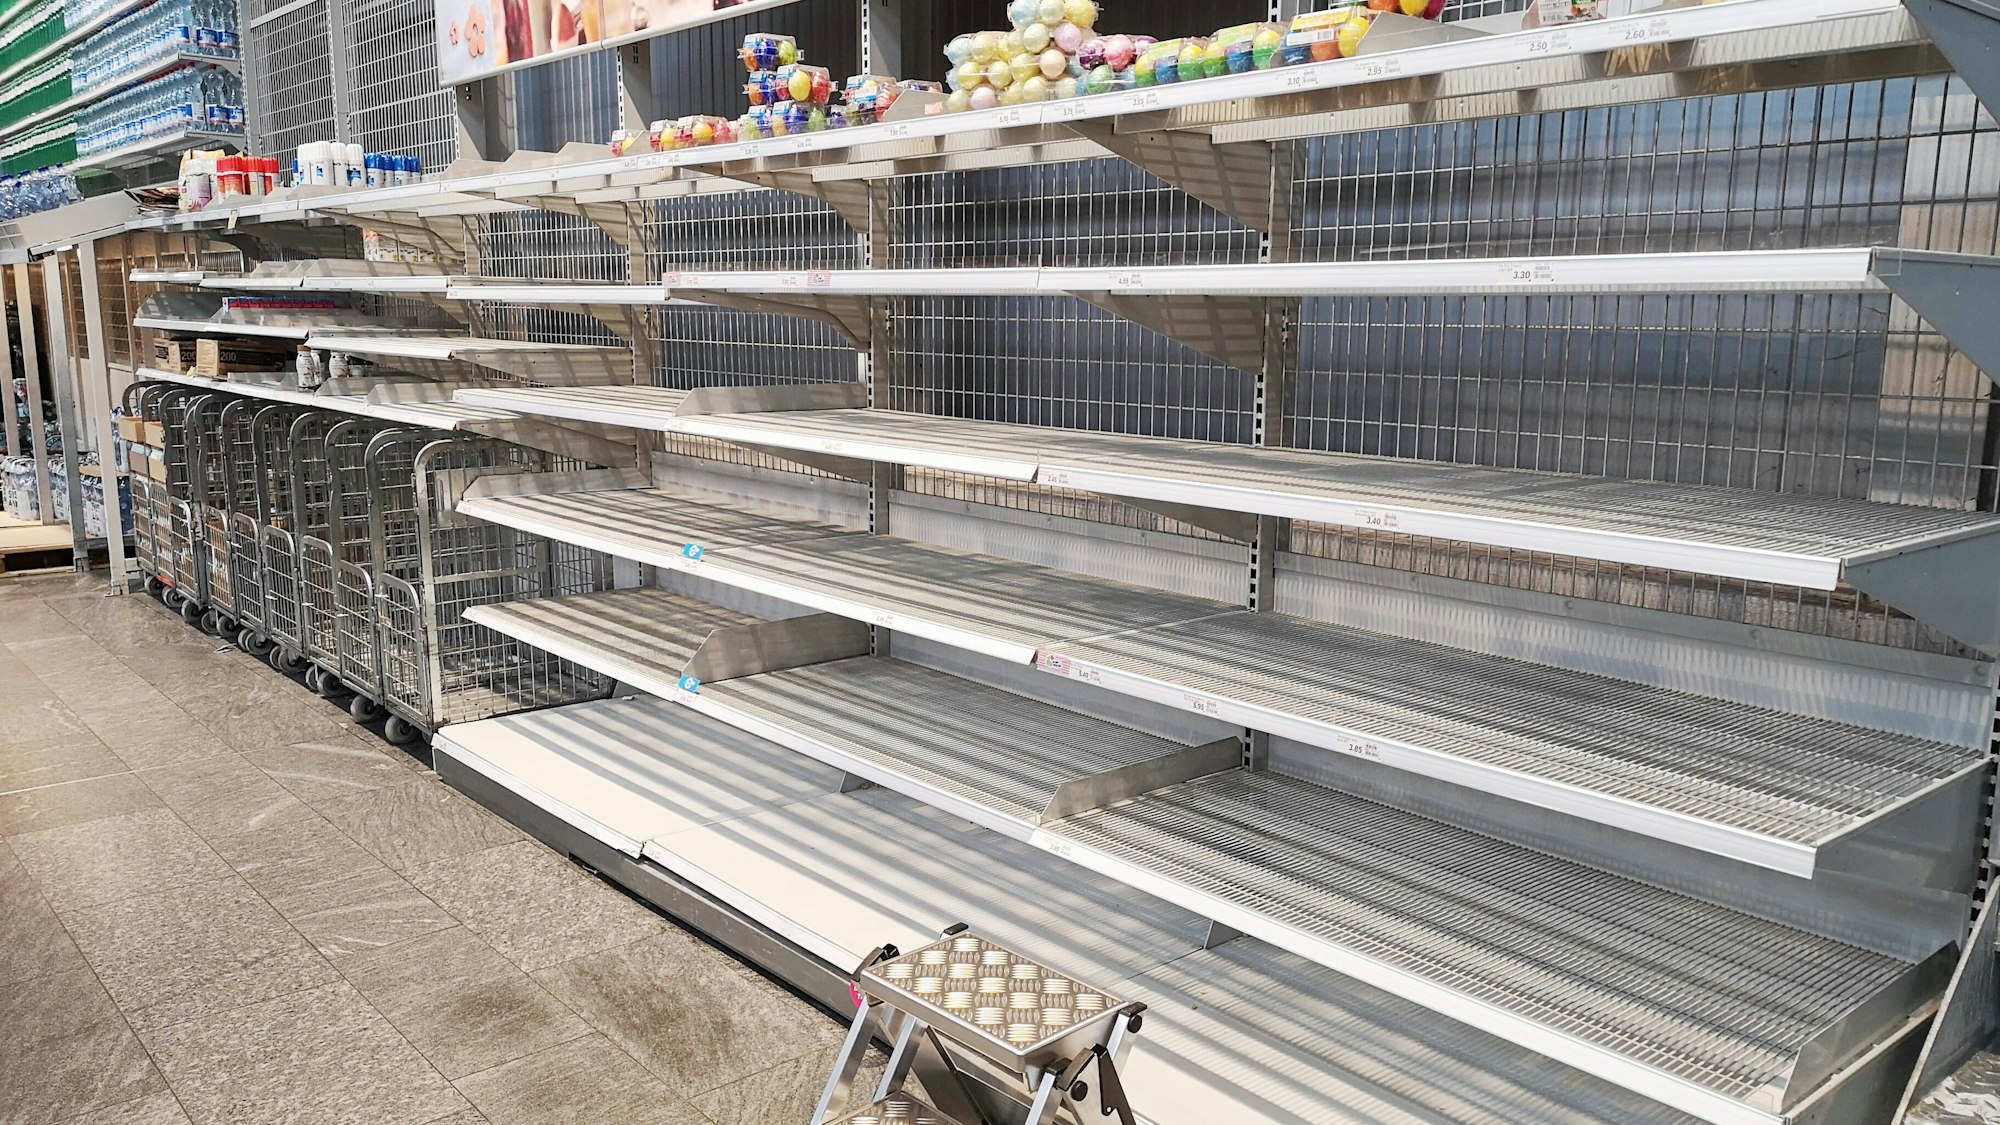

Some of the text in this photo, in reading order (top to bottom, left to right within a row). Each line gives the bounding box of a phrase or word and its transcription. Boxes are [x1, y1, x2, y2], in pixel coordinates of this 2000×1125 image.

[1625, 29, 1645, 40] 2.60
[1529, 41, 1548, 52] 2.50
[1367, 66, 1383, 77] 2.95
[1287, 76, 1301, 86] 3.10
[1513, 271, 1531, 279] 3.30
[220, 351, 237, 362] 200
[1366, 516, 1381, 526] 3.40
[1193, 701, 1205, 711] 5.95
